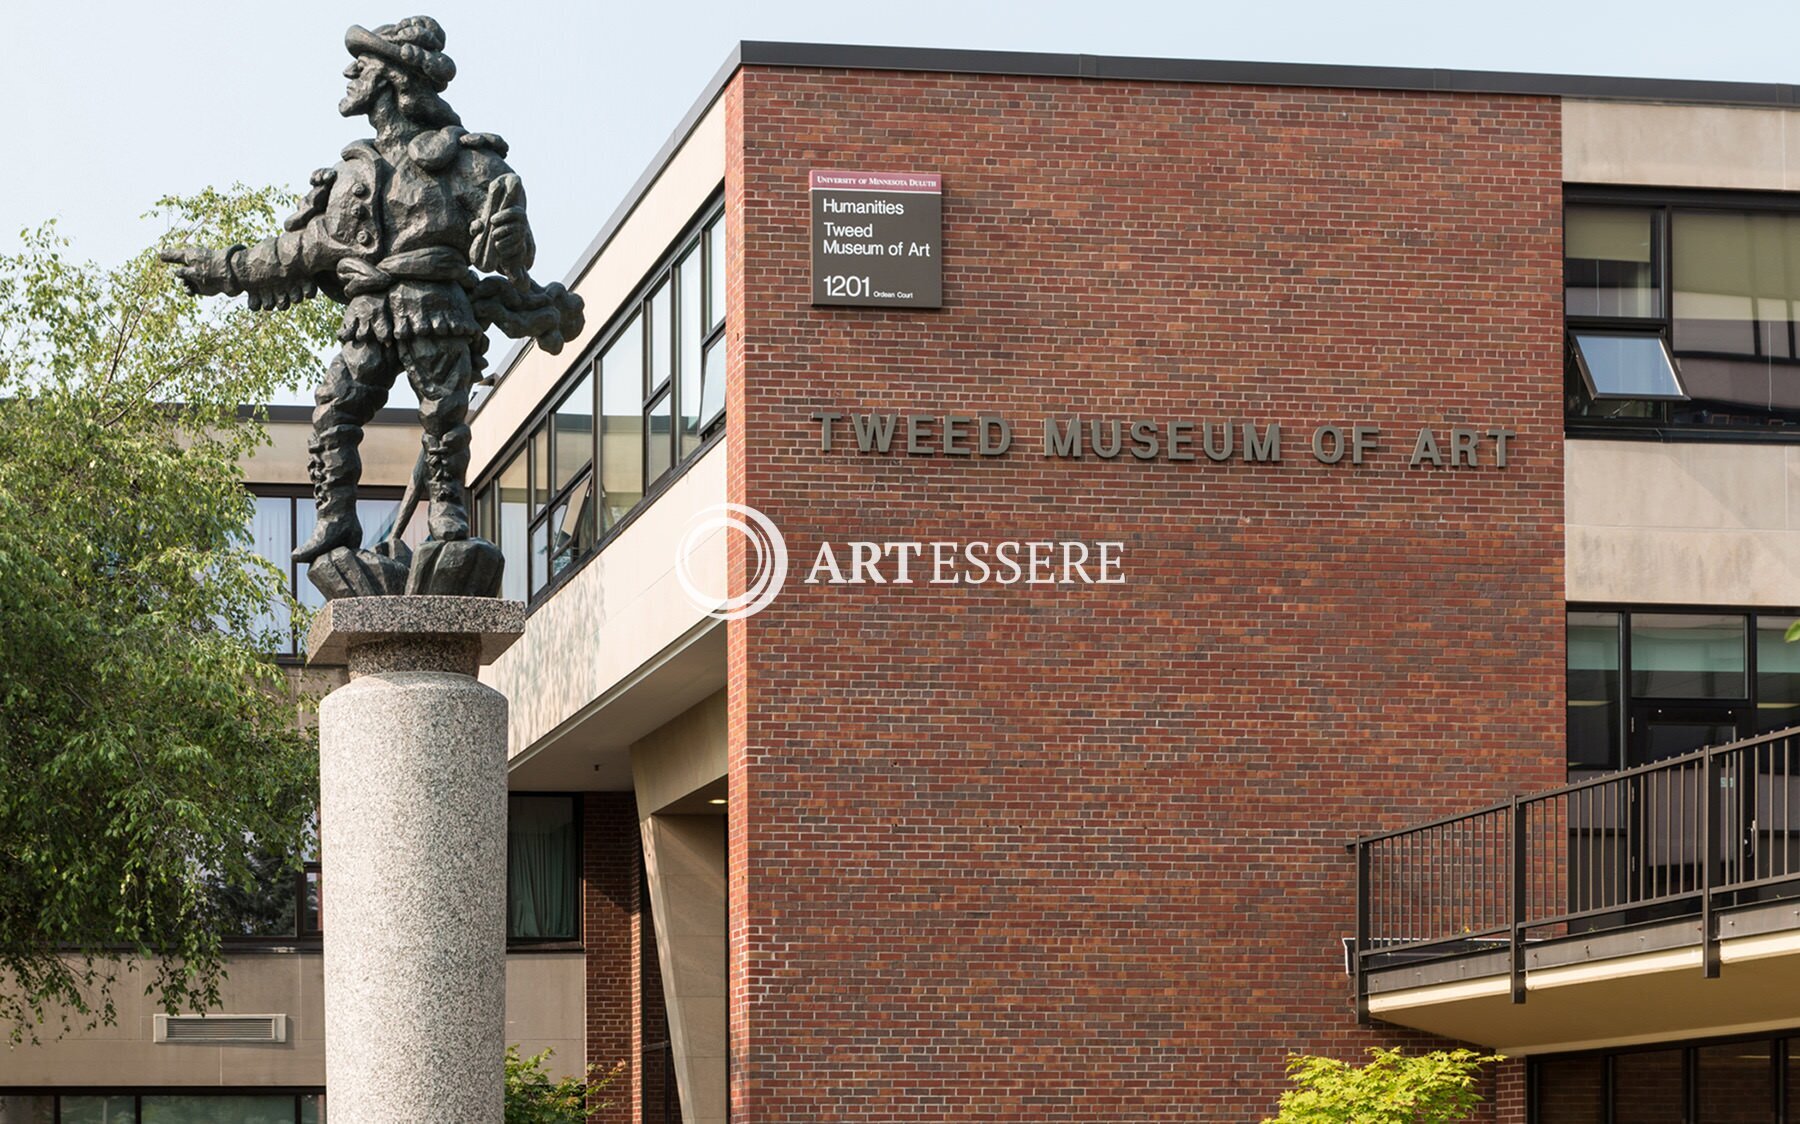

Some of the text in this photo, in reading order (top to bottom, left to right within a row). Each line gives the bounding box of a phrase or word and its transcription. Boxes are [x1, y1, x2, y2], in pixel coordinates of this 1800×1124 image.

[823, 198, 904, 215] Humanities
[823, 222, 873, 238] Tweed
[823, 239, 931, 257] Museum of Art
[823, 275, 870, 297] 1201
[812, 411, 1516, 468] TWEED MUSEUM OF ART
